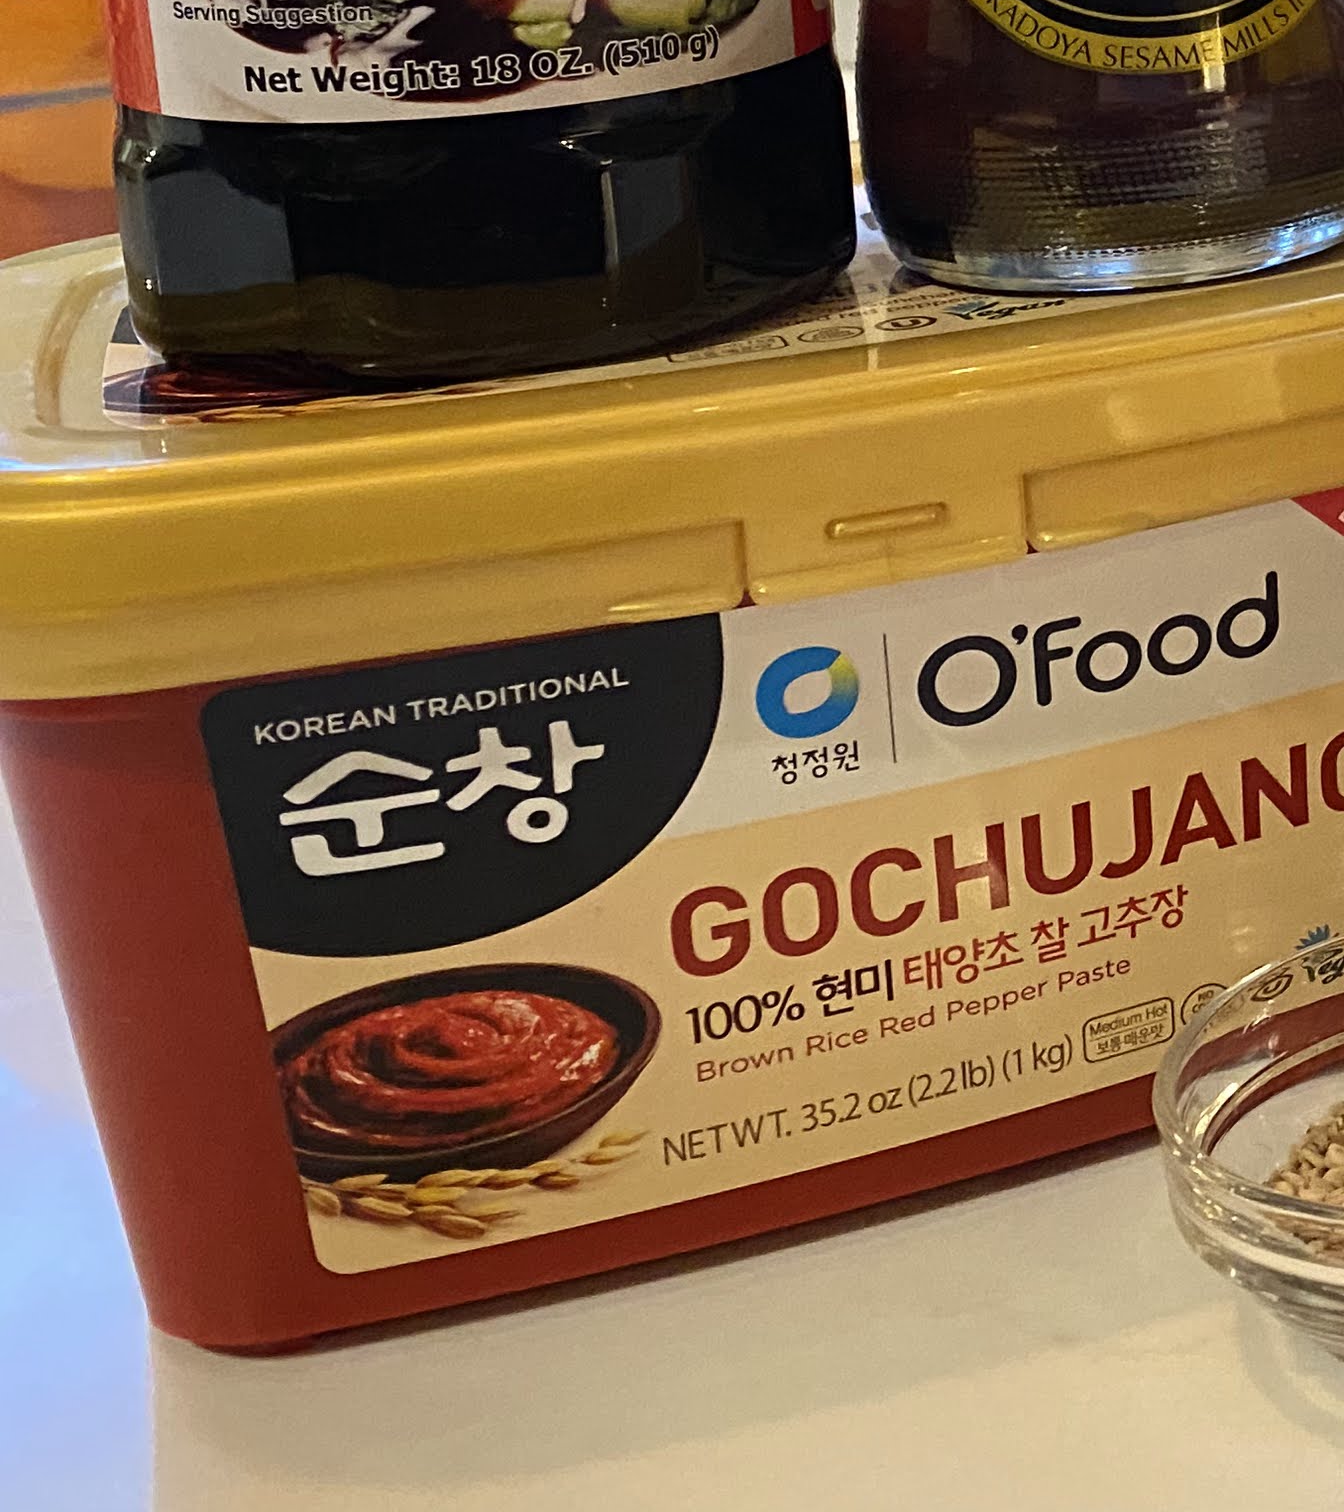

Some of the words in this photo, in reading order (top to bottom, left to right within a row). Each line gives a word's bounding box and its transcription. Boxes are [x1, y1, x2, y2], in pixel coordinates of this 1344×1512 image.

[173, 1, 239, 26] Serving
[245, 2, 373, 26] Suggestion
[1103, 40, 1218, 69] SESAME
[1221, 7, 1289, 57] MILLS
[243, 65, 302, 94] Net
[311, 60, 461, 99] Weight:
[472, 54, 519, 86] 18
[527, 47, 595, 78] OZ.
[601, 33, 682, 74] (510
[688, 26, 720, 64] g)
[255, 705, 397, 744] KOREAN
[406, 668, 629, 722] TRADITIONAL
[279, 720, 604, 876] 순창
[771, 740, 860, 784] 청정원
[685, 989, 805, 1045] 100%
[812, 960, 895, 1018] 현미
[901, 932, 1023, 986] 태양초
[1031, 916, 1069, 961] 찰
[1075, 885, 1188, 947] 고추장
[696, 1043, 795, 1082] Brown
[806, 1026, 868, 1057] Rice
[879, 1011, 936, 1039] Red
[946, 978, 1049, 1022] Pepper
[1058, 957, 1131, 991] Paste
[1089, 1012, 1142, 1037] Medium
[1146, 1003, 1168, 1020] Hot
[802, 1091, 862, 1134] 35.2
[867, 1087, 904, 1114] oz
[1001, 1047, 1025, 1082] (1
[1032, 1033, 1073, 1076] kg)
